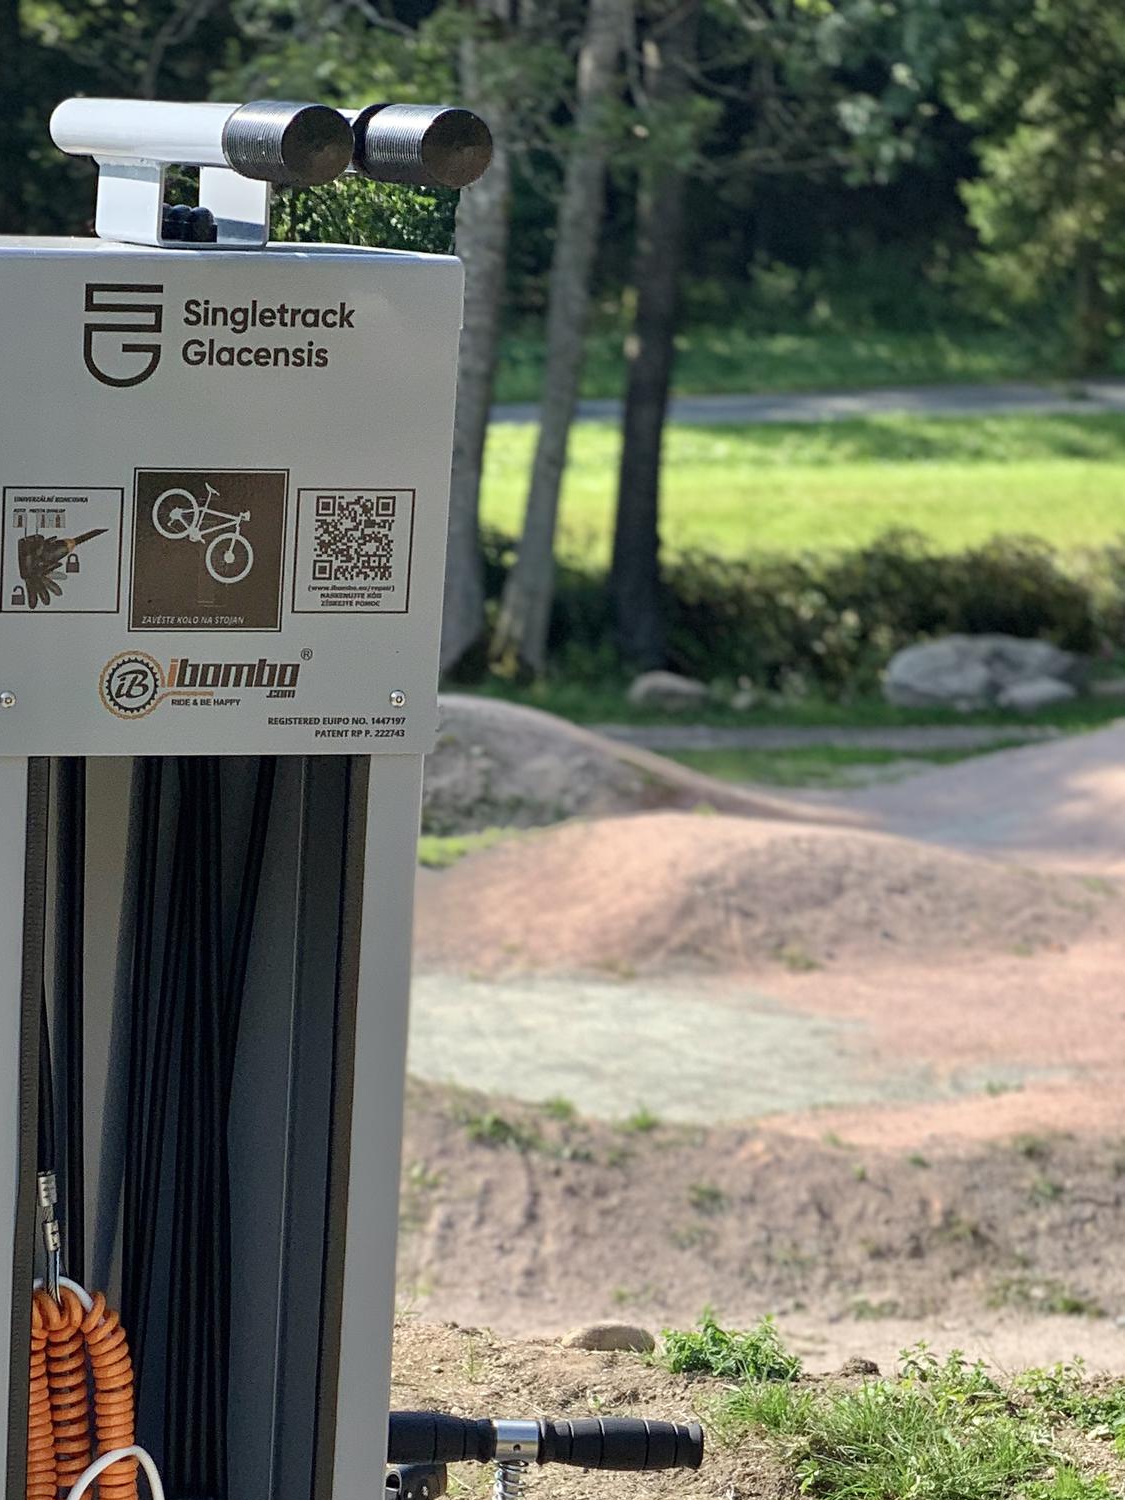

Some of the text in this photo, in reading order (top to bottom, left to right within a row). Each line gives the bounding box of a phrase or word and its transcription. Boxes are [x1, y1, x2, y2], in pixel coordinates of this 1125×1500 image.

[183, 299, 356, 334] Singletrack
[181, 338, 329, 368] Glacensis
[176, 615, 199, 625] KOLO
[200, 615, 213, 625] NA
[214, 615, 245, 625] STOJAN
[167, 658, 300, 688] ibombo
[171, 698, 191, 706] RIDE
[268, 717, 406, 725] REGISTERED EUIPO NO. 1447197
[315, 729, 405, 738] PATENT RP P. 222743
